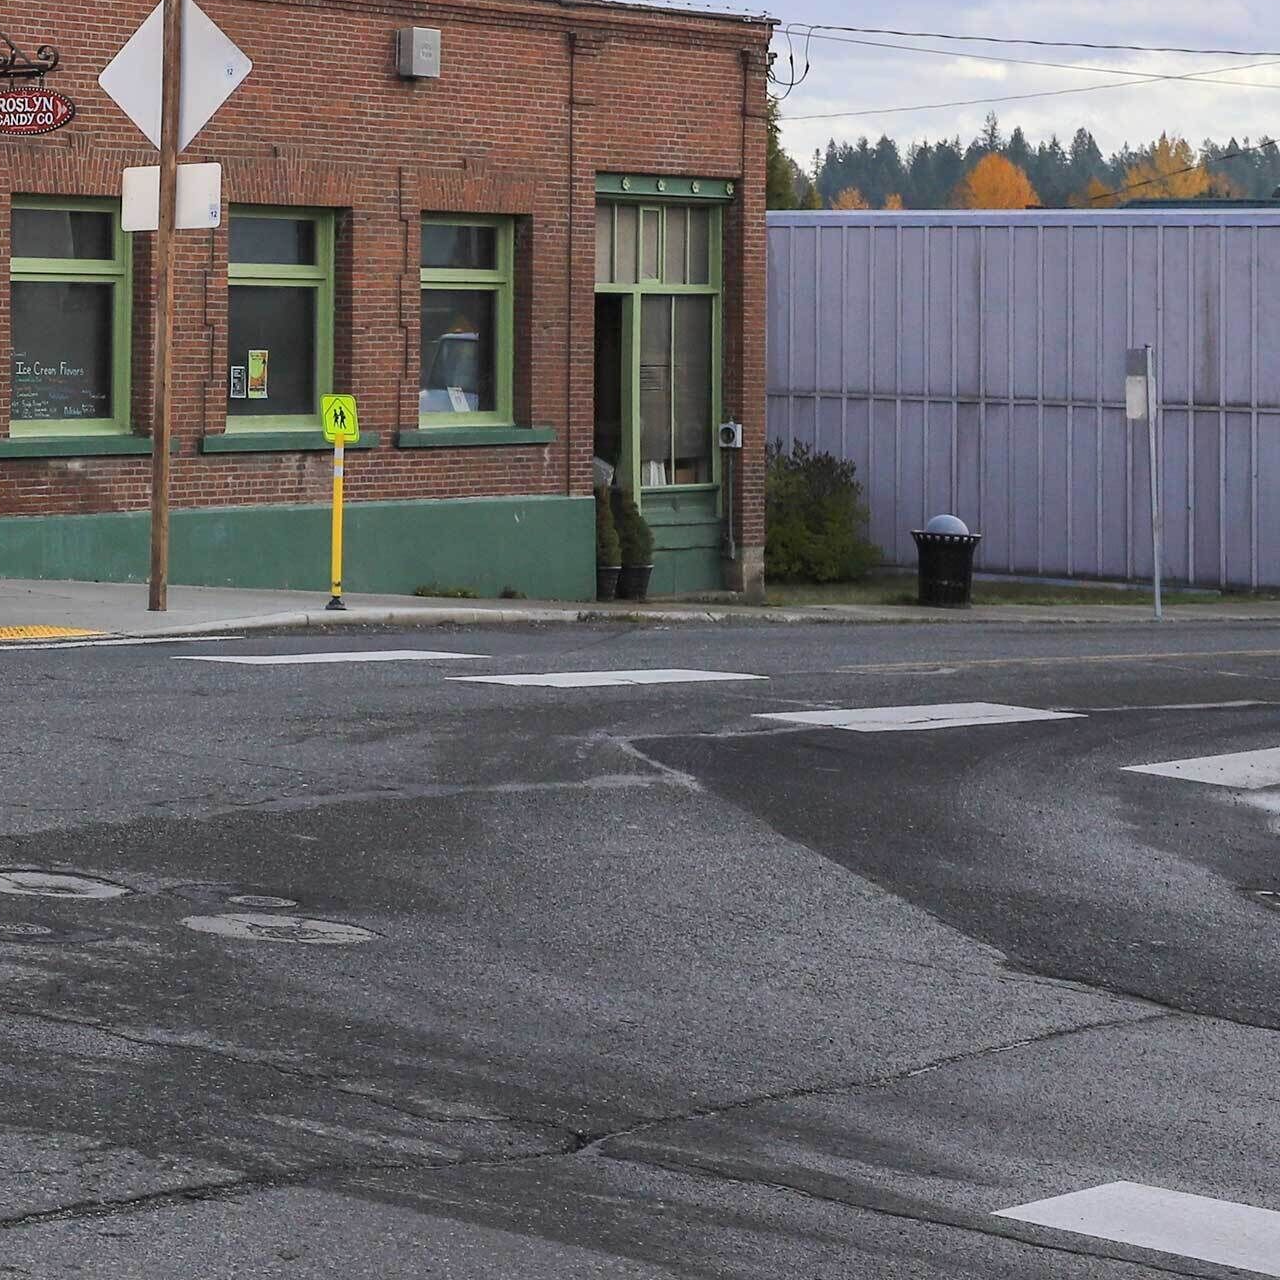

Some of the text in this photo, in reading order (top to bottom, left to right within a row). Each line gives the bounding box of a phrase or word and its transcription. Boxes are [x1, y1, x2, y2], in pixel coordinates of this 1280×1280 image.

[15, 361, 85, 376] Ice Cream Flavors
